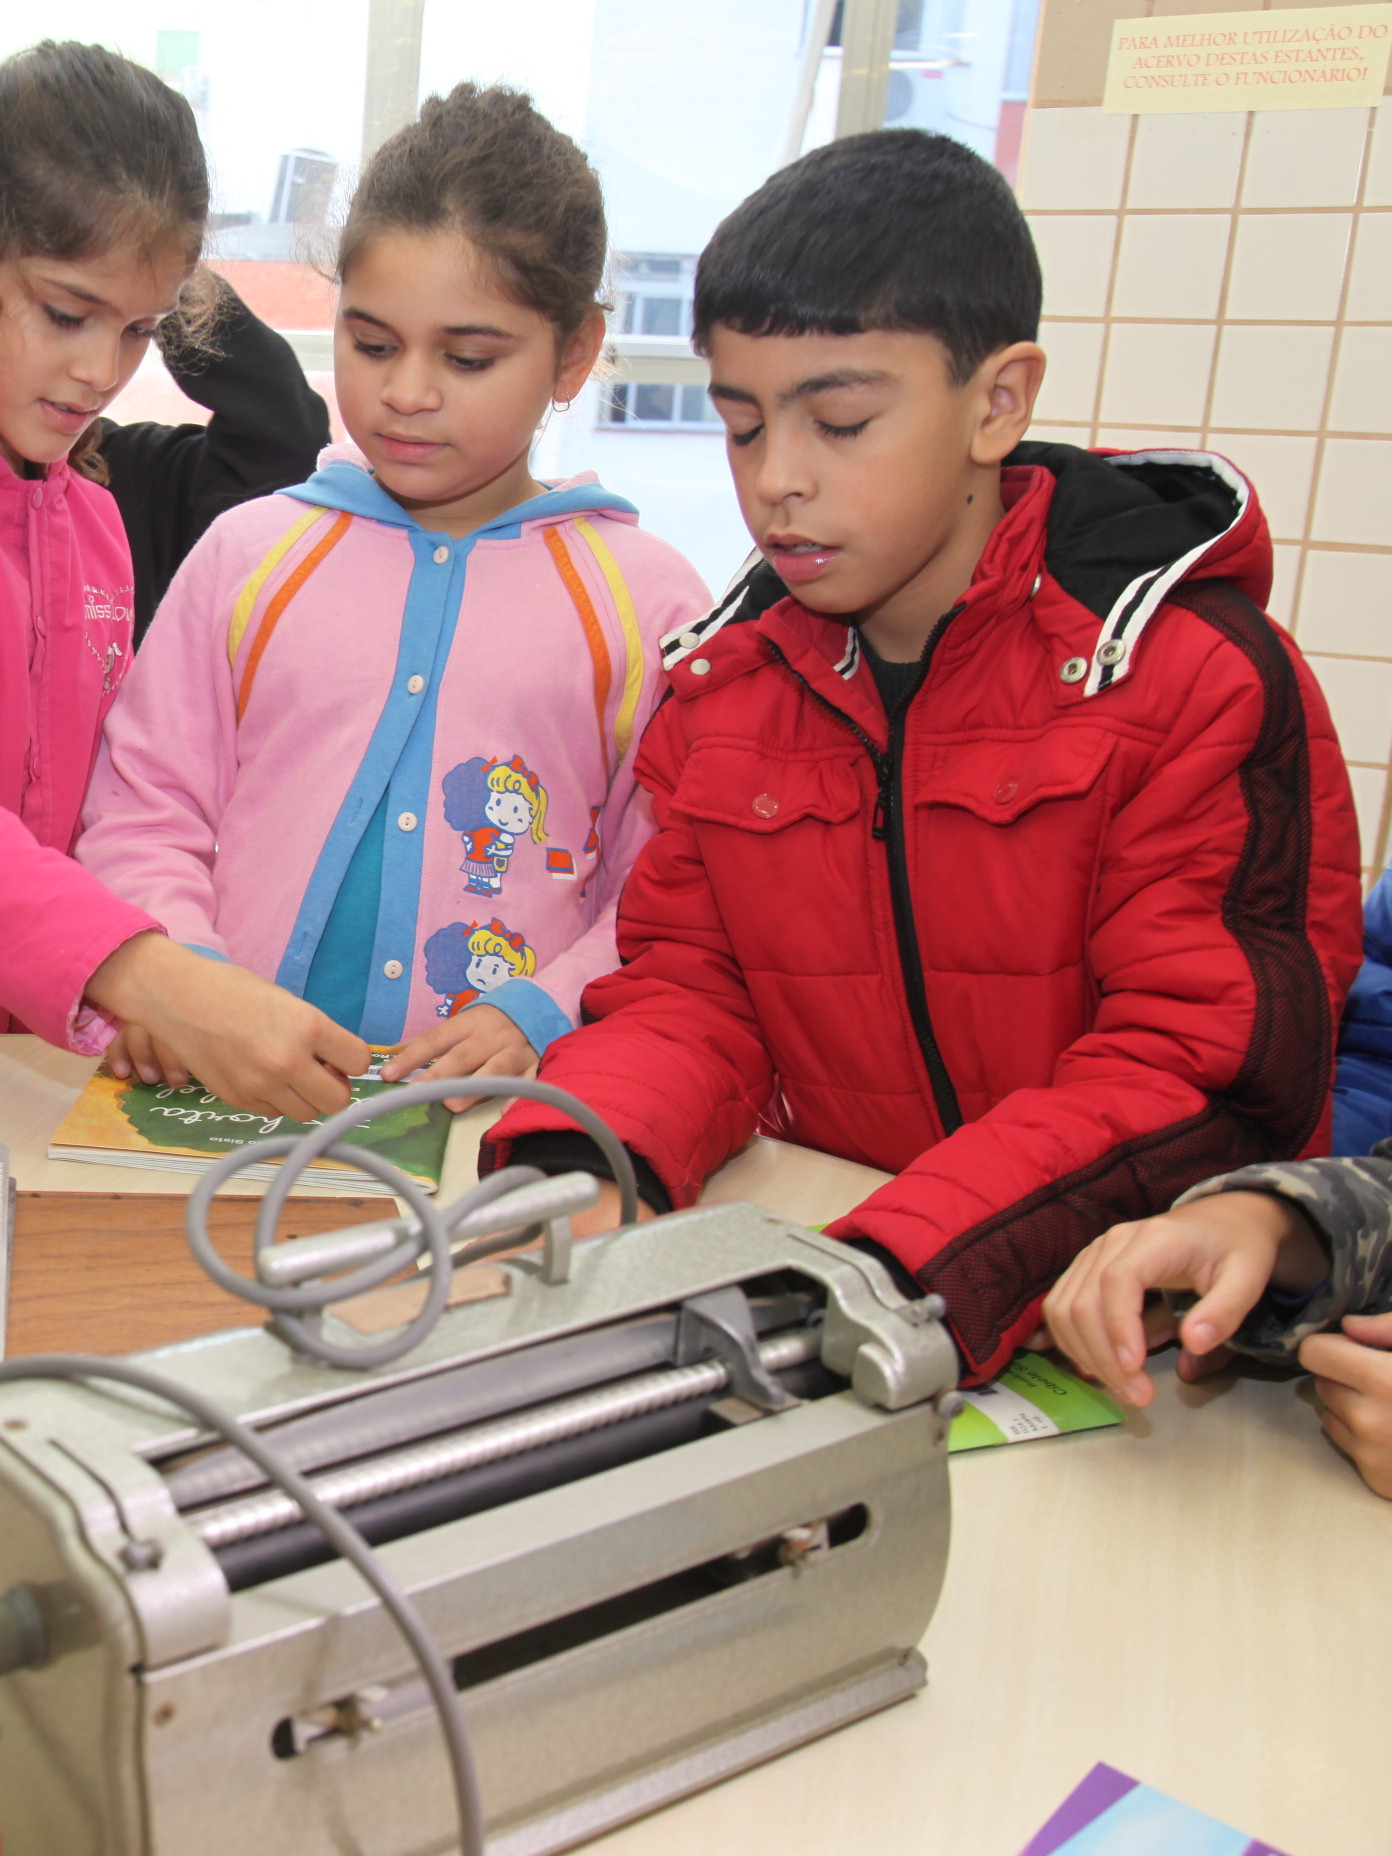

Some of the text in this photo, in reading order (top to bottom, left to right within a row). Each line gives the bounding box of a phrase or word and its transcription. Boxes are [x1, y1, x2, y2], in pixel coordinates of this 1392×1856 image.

[1117, 24, 1389, 50] PARA MELHOR UTILIZAÇÃO DO
[1132, 46, 1364, 70] ACERVO DESTAS ESTANTES,
[1122, 67, 1368, 90] CONSULTE O FUNCIONÁRIO!
[149, 1107, 284, 1134] horta
